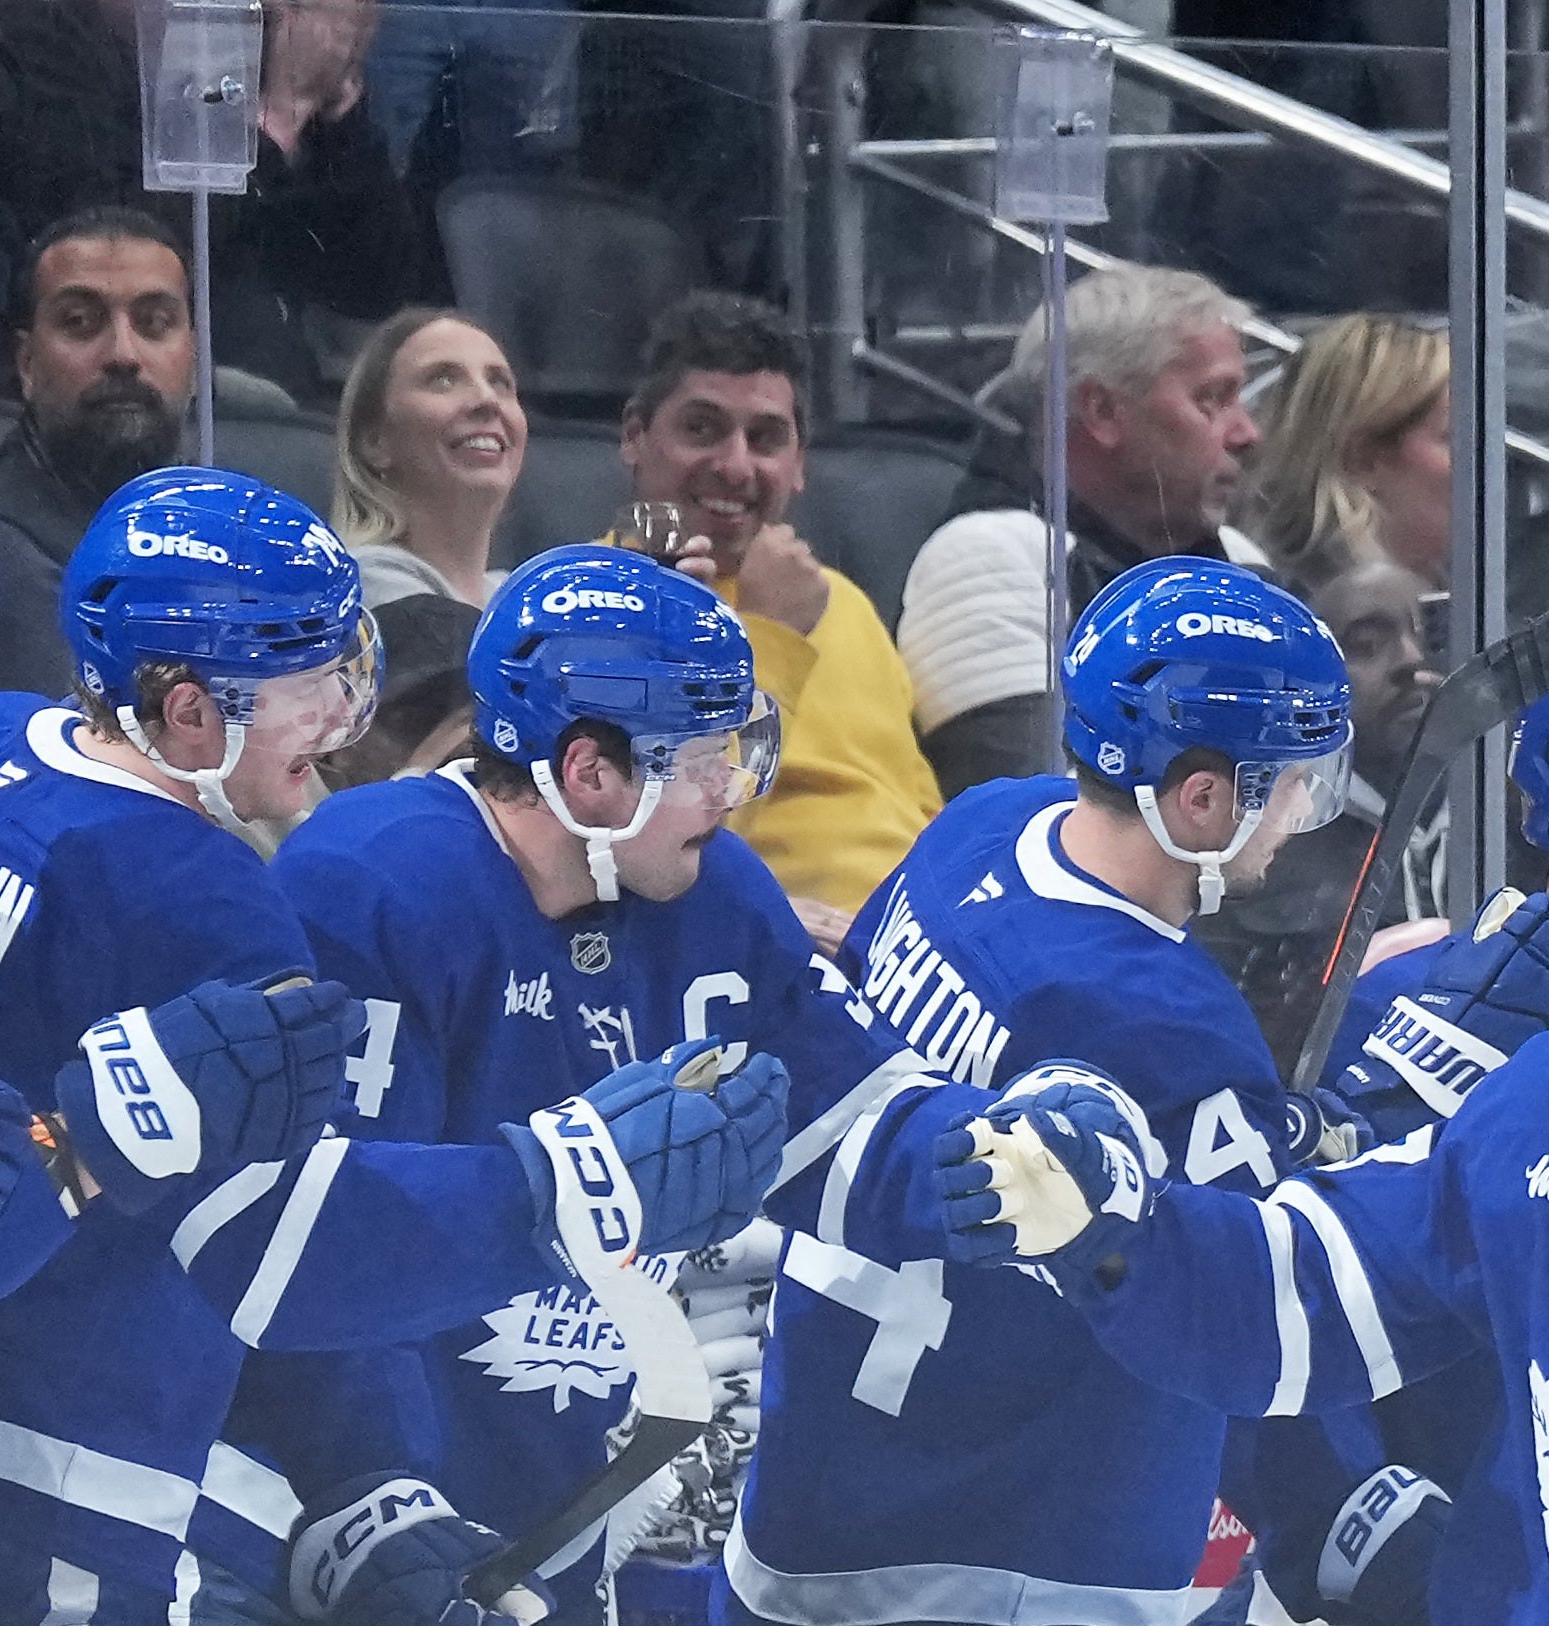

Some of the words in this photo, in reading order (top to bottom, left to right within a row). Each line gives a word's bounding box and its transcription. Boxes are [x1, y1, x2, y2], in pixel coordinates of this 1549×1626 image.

[127, 530, 229, 564] OREO
[541, 589, 645, 615] OREO
[1176, 612, 1282, 642] OREO
[682, 970, 750, 1076] C
[545, 1100, 631, 1253] CCM
[1184, 1087, 1272, 1189] 4
[311, 1489, 435, 1608] CCM
